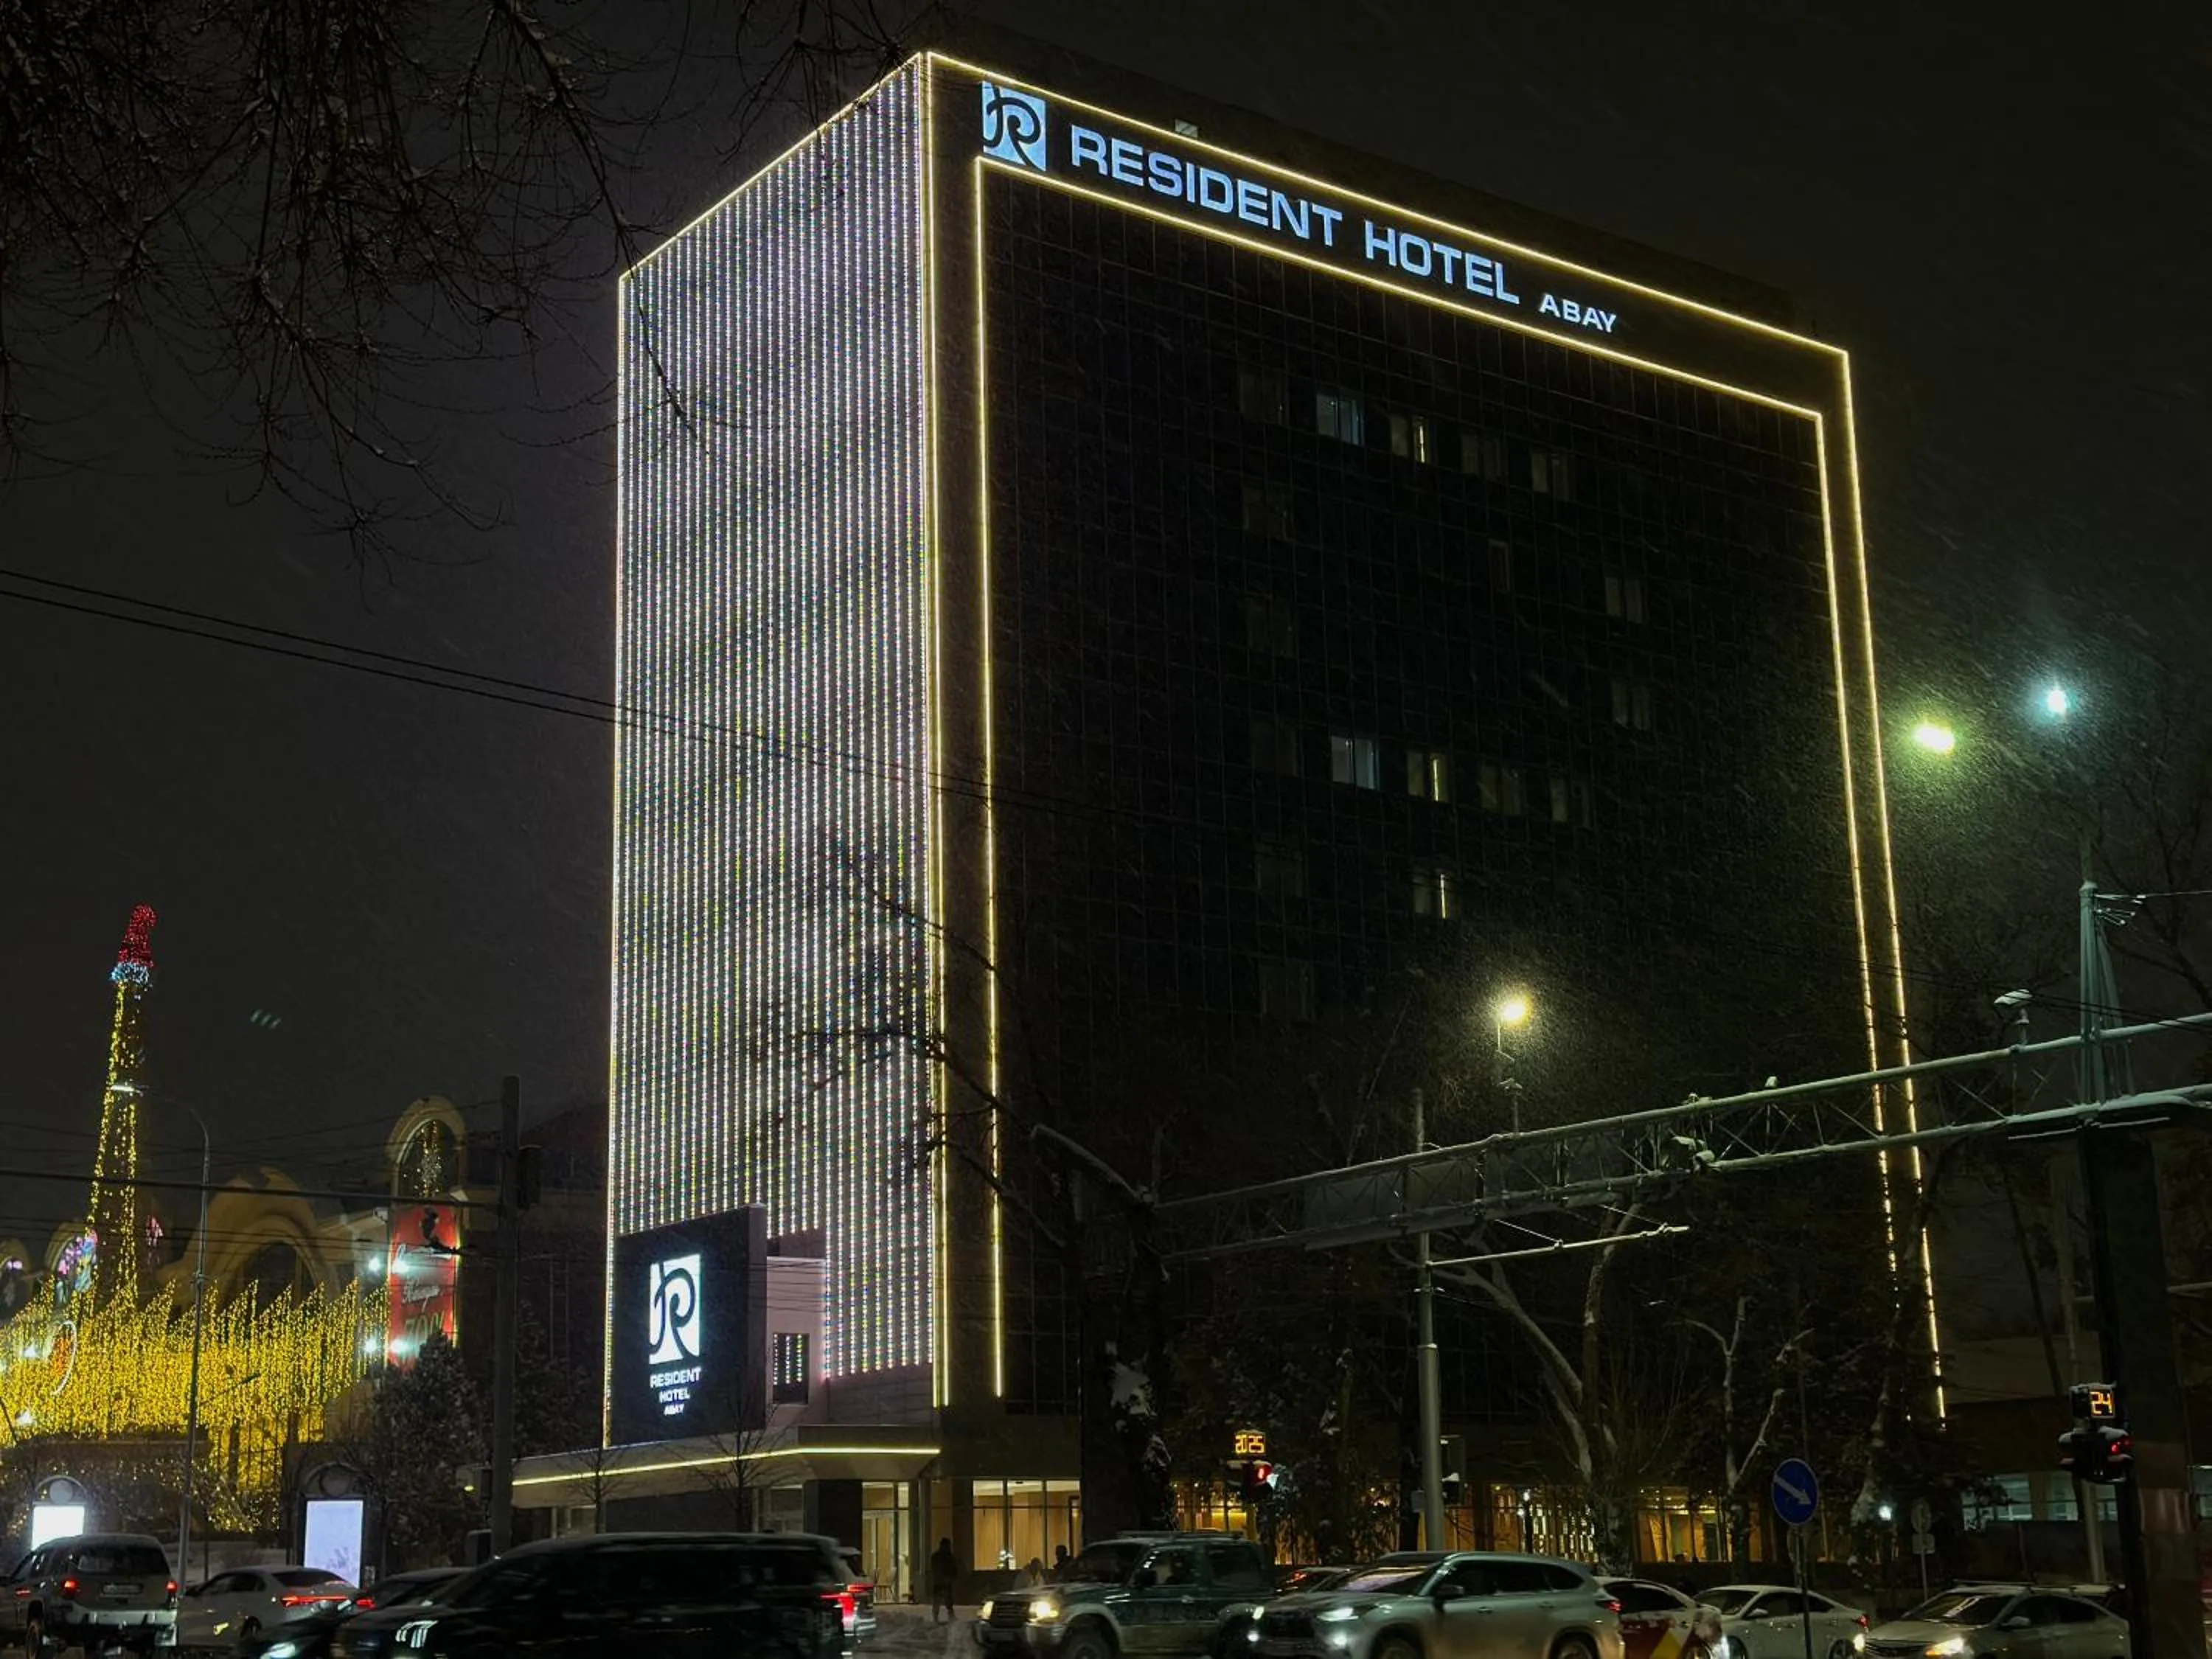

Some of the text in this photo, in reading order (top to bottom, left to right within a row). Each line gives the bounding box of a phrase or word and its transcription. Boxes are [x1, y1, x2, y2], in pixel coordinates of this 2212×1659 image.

[1071, 124, 1616, 333] RESIDENT HOTEL ABAY
[650, 1366, 701, 1388] RESIDENT
[659, 1388, 690, 1404] HOTEL
[2090, 1391, 2112, 1414] 24
